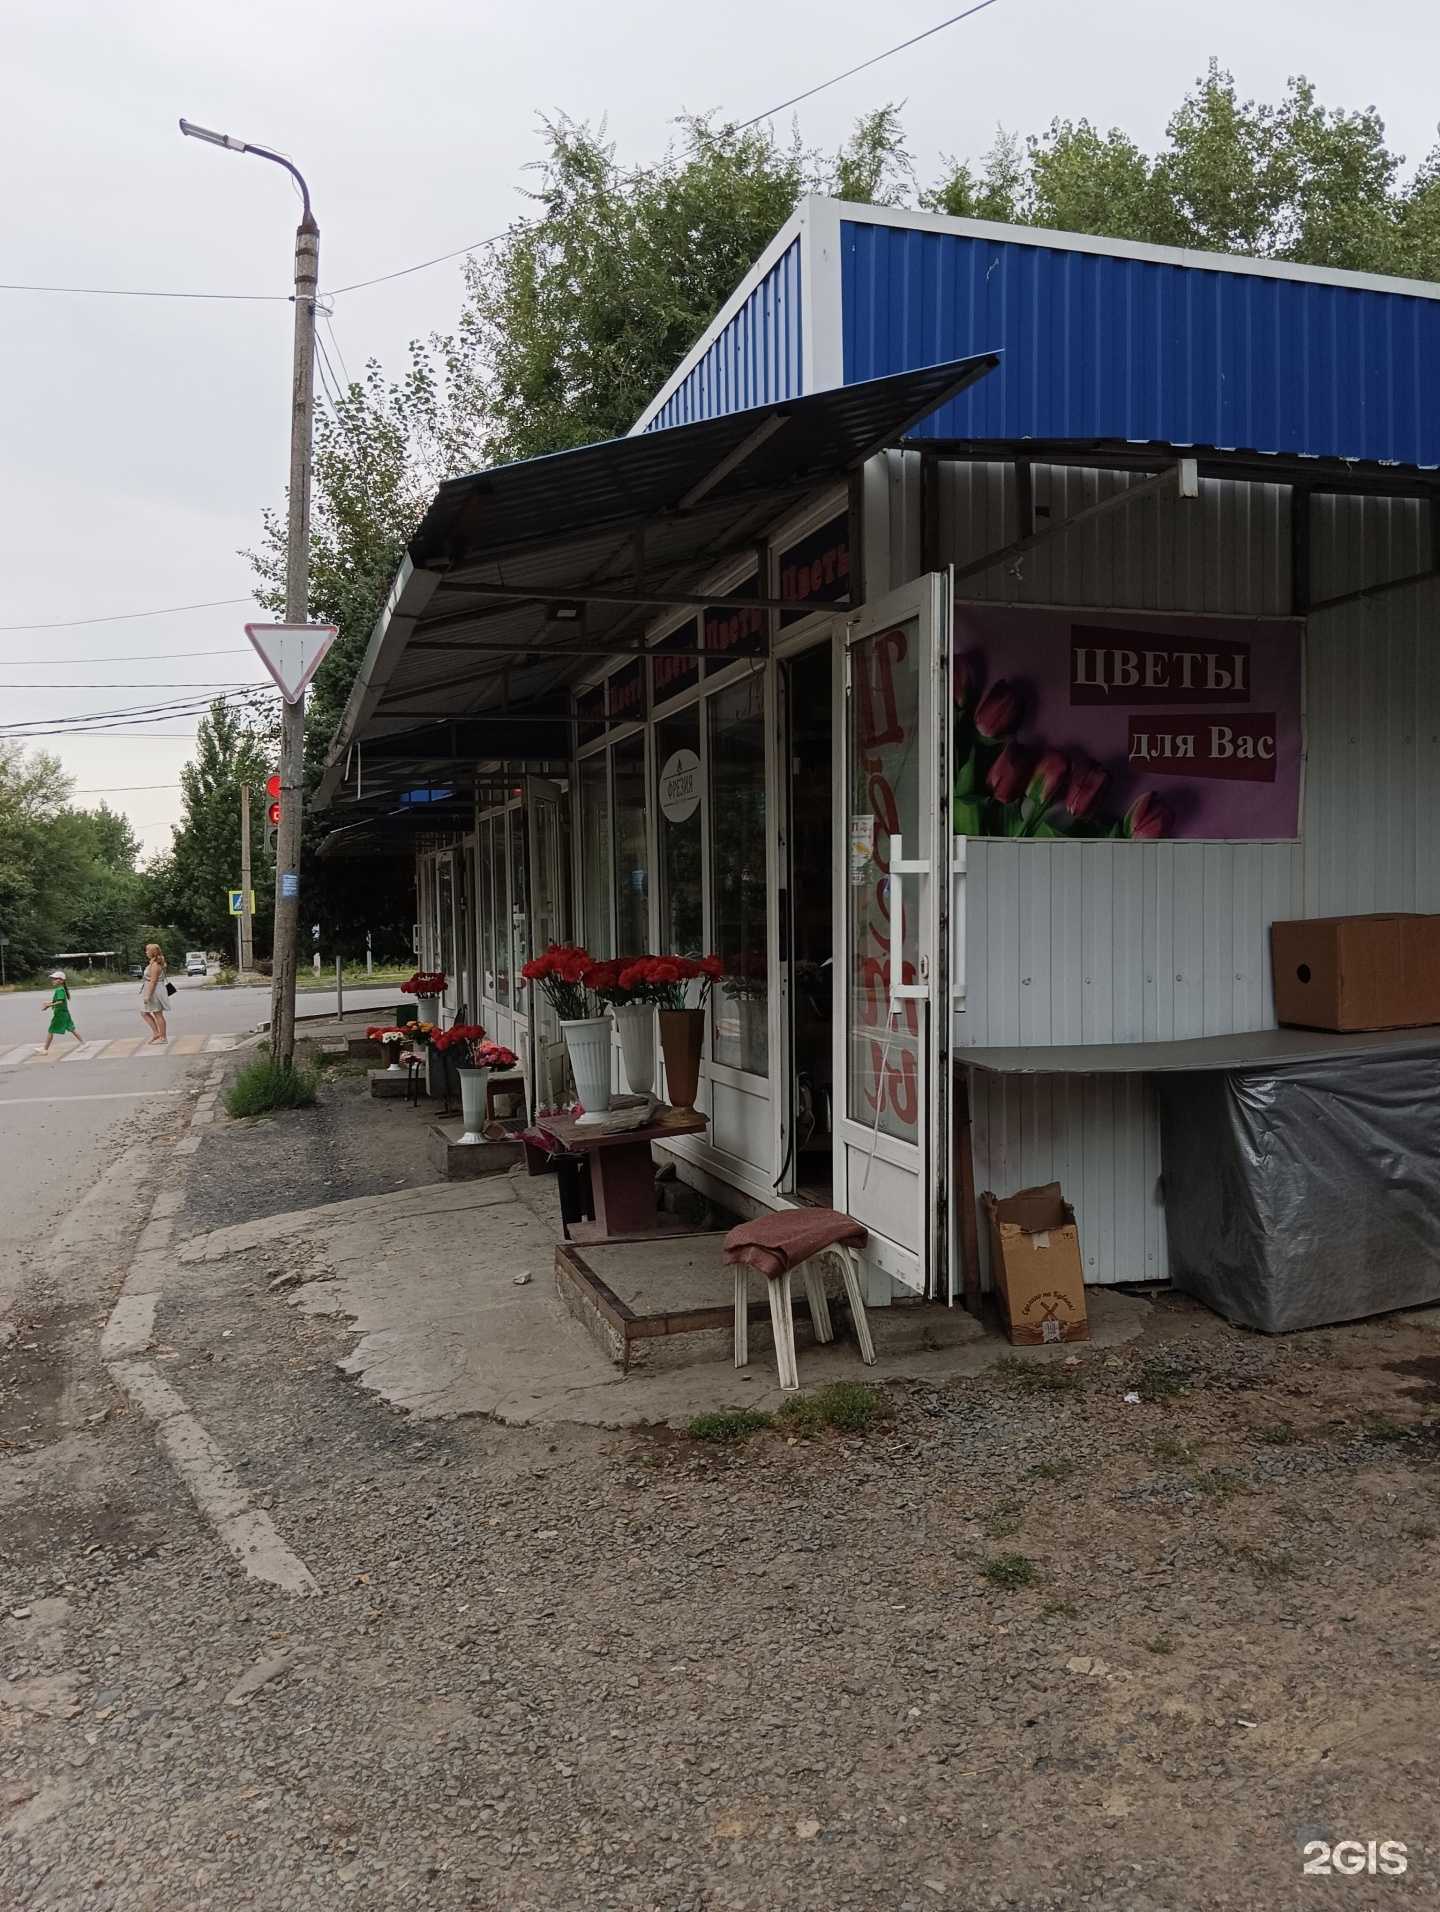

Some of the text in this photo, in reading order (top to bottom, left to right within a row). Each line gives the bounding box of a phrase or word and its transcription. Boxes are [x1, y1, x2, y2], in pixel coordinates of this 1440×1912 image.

[1073, 648, 1248, 694] ЦВЕТЫ
[1128, 726, 1275, 763] для Вас
